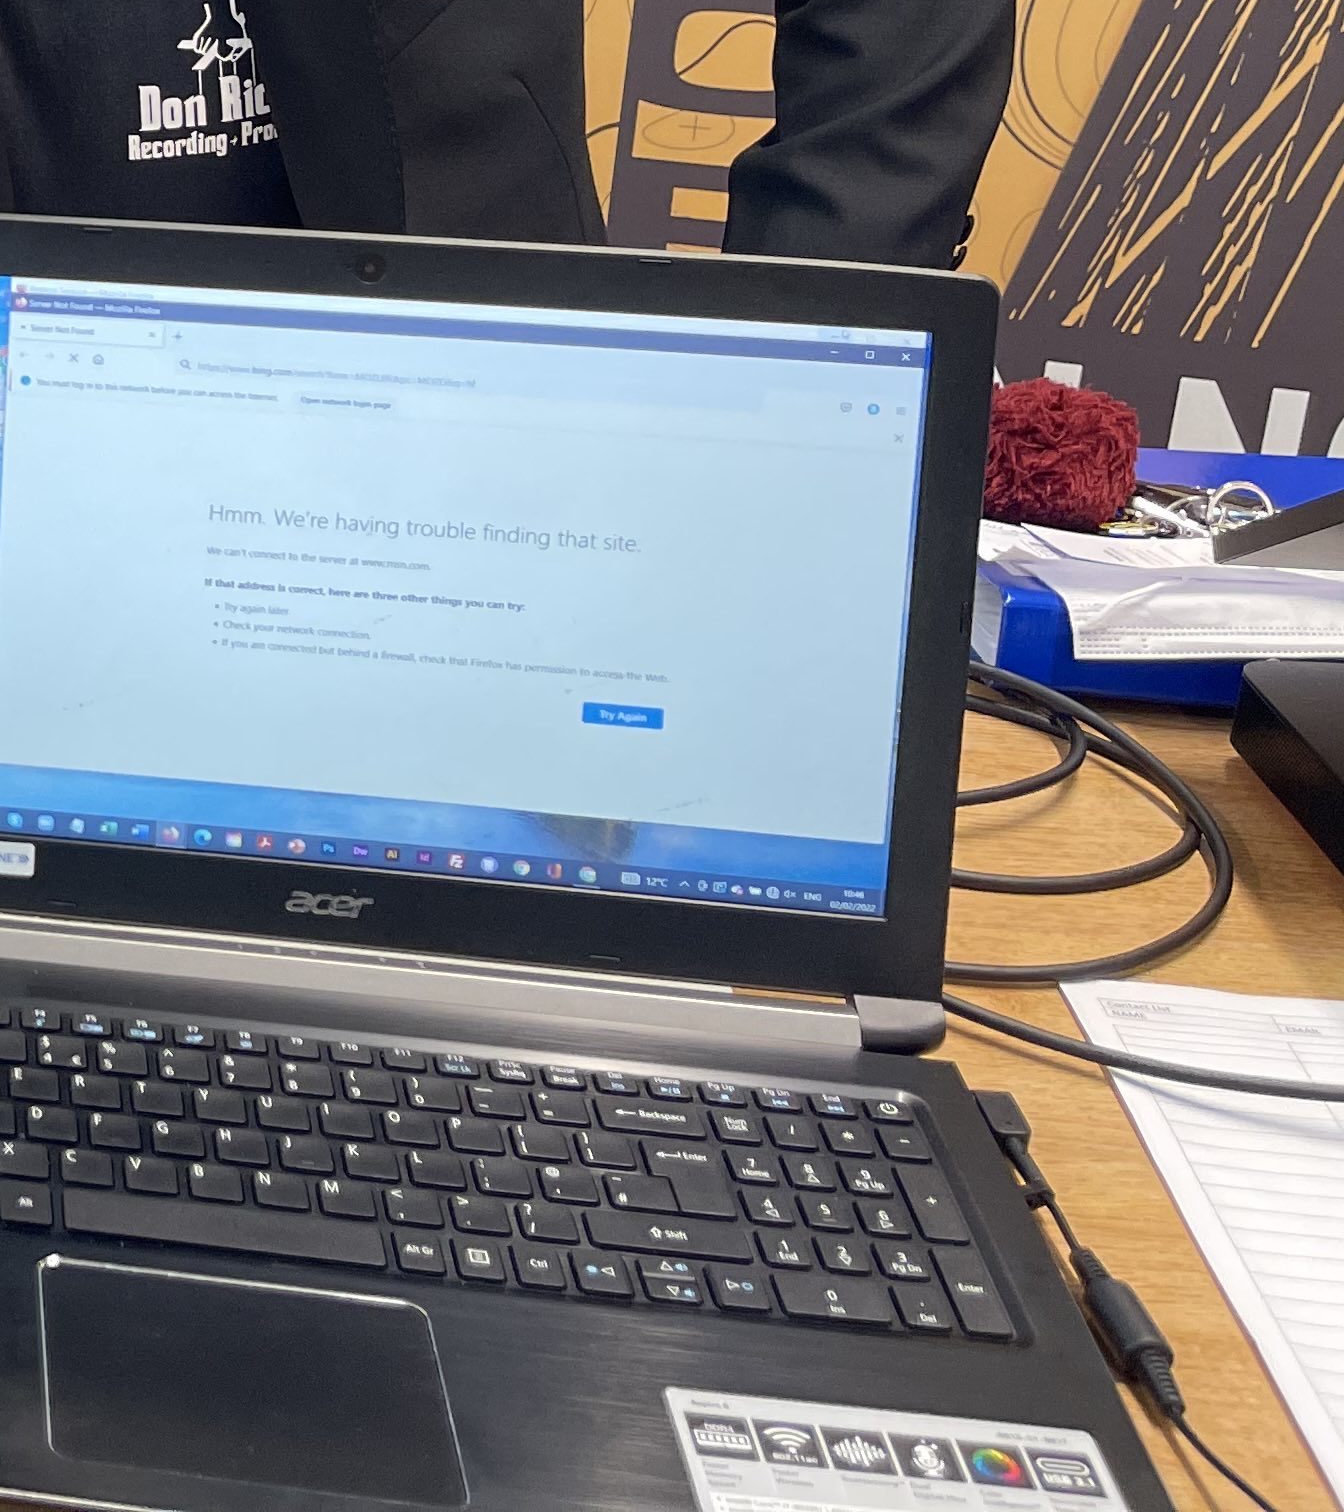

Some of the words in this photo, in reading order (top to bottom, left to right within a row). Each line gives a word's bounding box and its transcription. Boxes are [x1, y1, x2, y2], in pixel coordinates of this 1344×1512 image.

[138, 85, 207, 132] Don
[219, 74, 271, 123] Ric
[128, 131, 228, 161] Recording
[241, 120, 278, 147] Pro
[208, 504, 266, 527] Hmm.
[274, 508, 329, 530] We're
[335, 513, 400, 538] having
[406, 518, 477, 541] trouble
[483, 523, 551, 551] finding
[557, 529, 597, 551] that
[603, 534, 642, 554] site.
[215, 579, 235, 590] that
[328, 588, 351, 599] here
[353, 592, 370, 601] are
[372, 591, 399, 603] three
[401, 593, 429, 605] other
[431, 595, 463, 610] things
[465, 599, 485, 611] you
[487, 601, 505, 610] can
[599, 709, 615, 722] Try
[617, 710, 648, 724] Again
[285, 889, 375, 919] acer
[639, 1109, 687, 1123] Backspace
